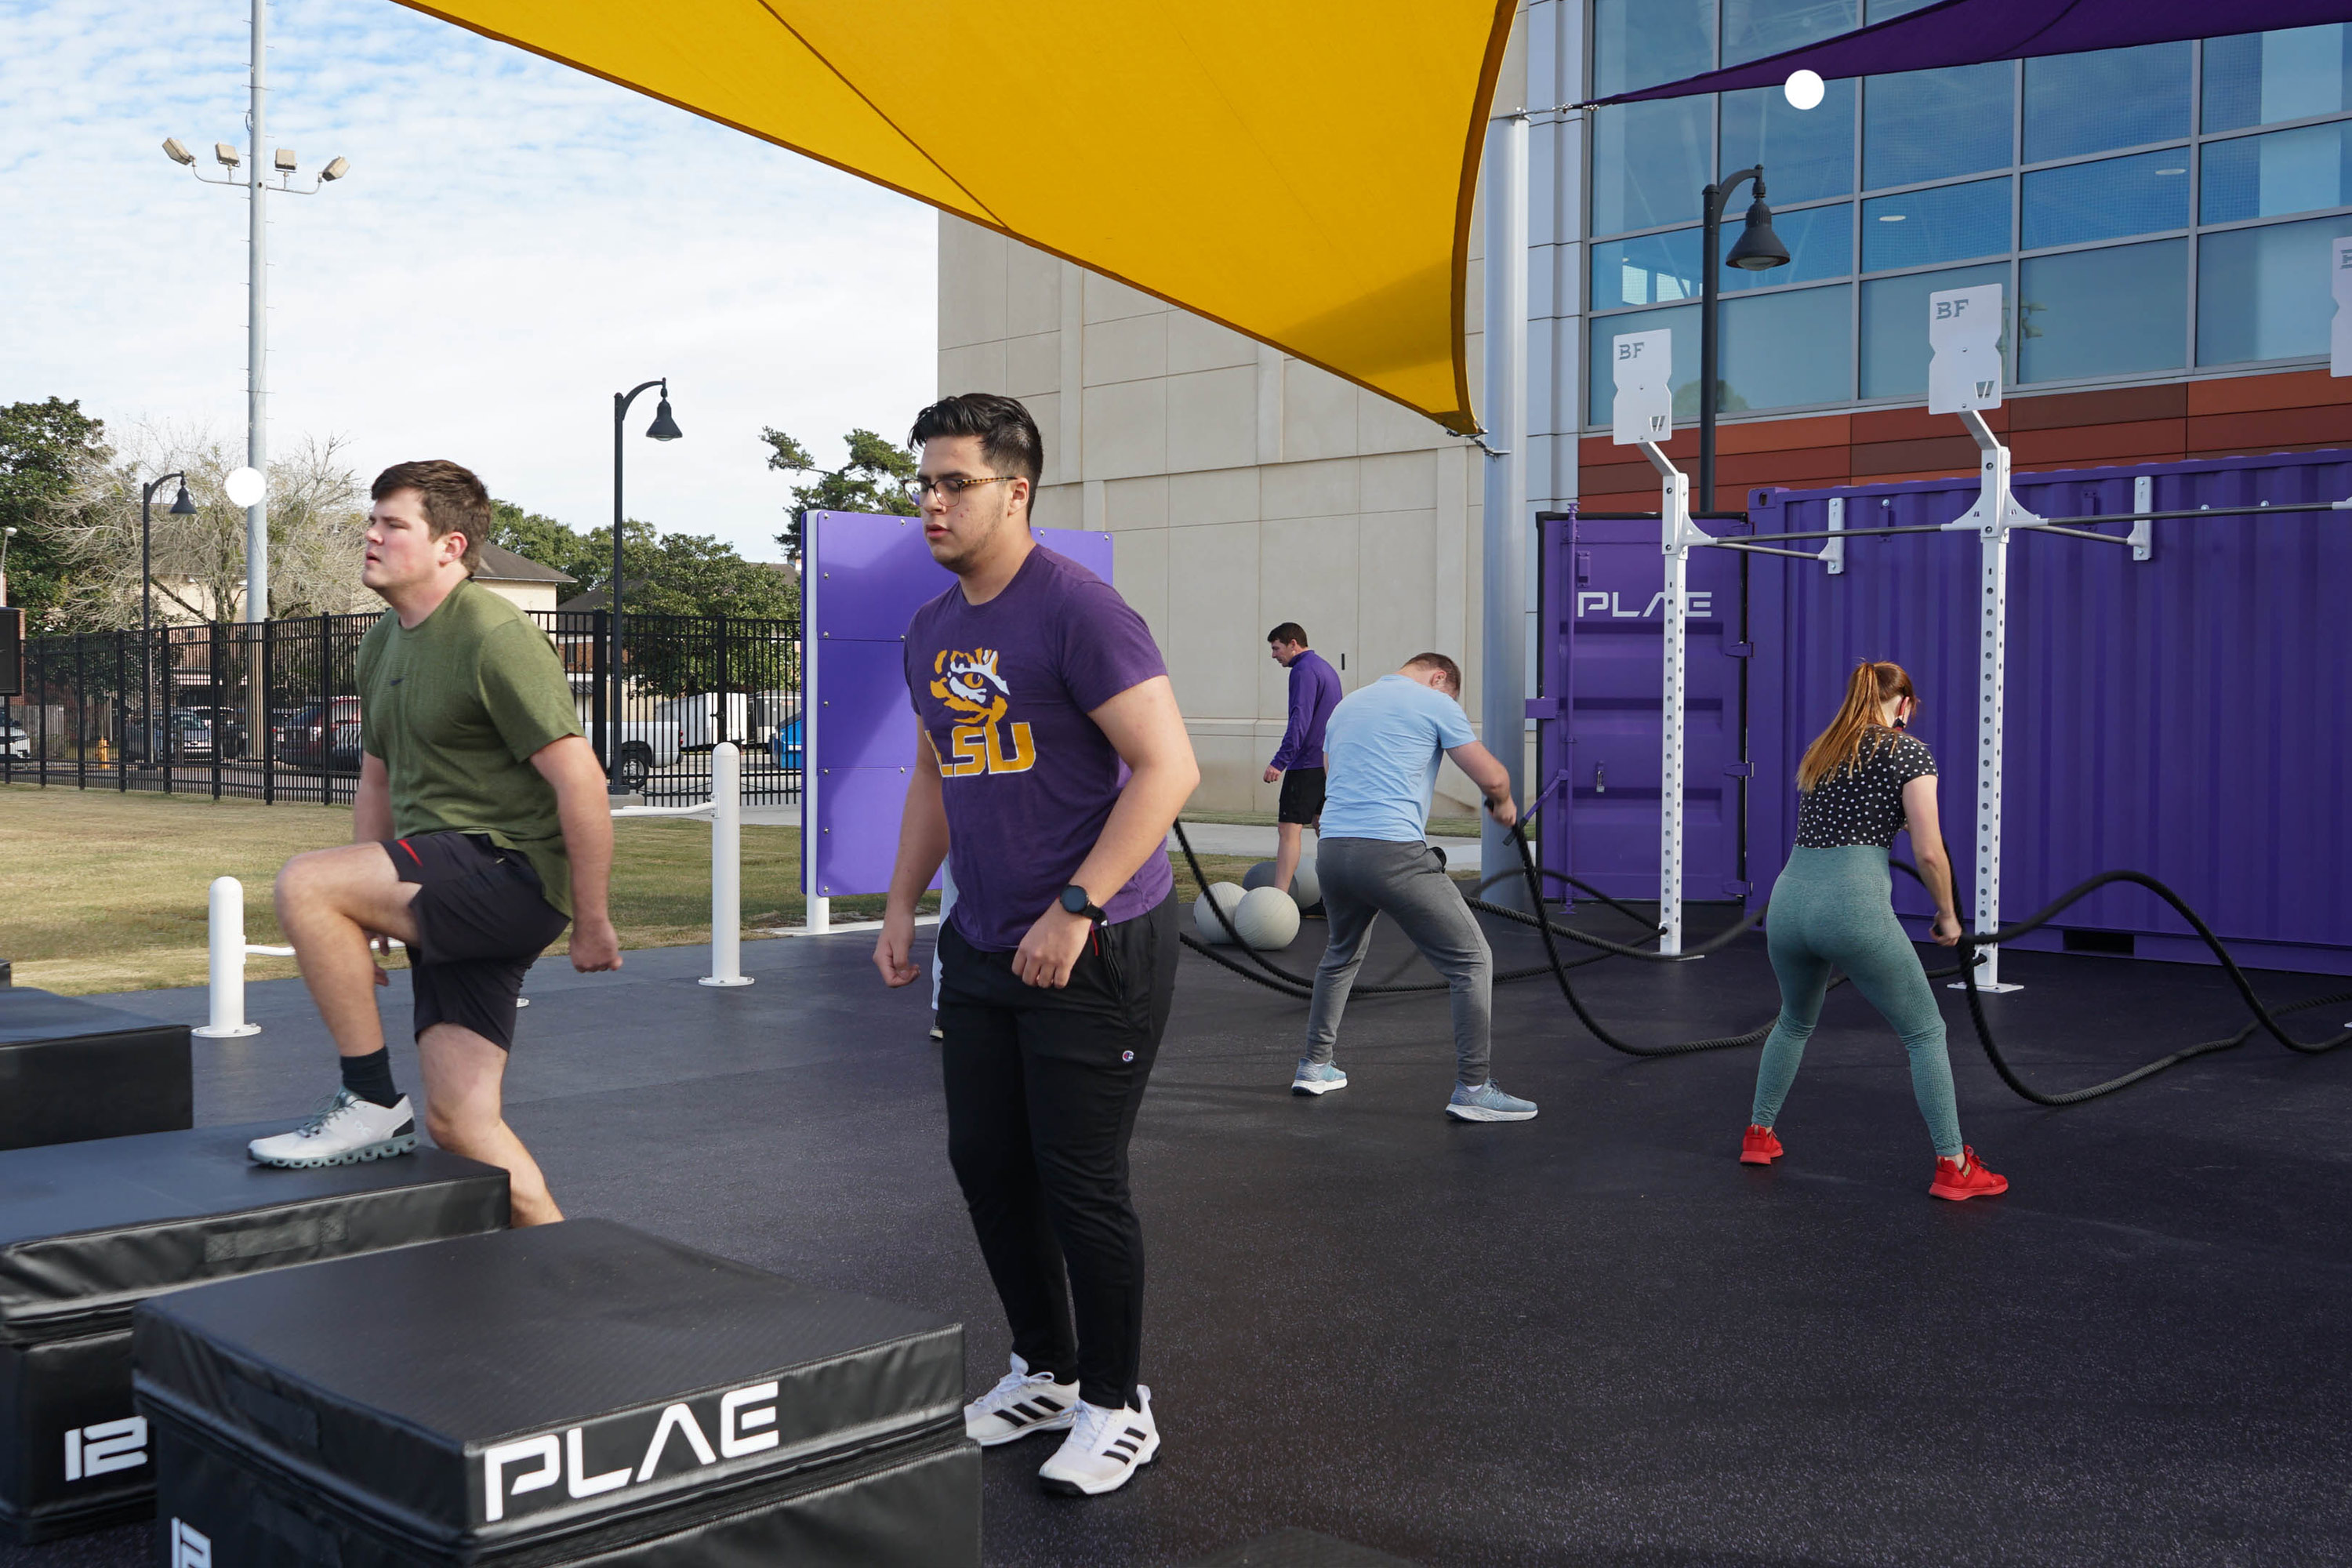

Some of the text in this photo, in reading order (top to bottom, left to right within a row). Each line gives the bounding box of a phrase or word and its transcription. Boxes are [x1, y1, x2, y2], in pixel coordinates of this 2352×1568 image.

[1936, 299, 1969, 320] BF
[1618, 342, 1645, 360] BF
[925, 721, 1036, 777] LSU
[64, 1415, 148, 1481] 12
[485, 1381, 779, 1523] PLAE
